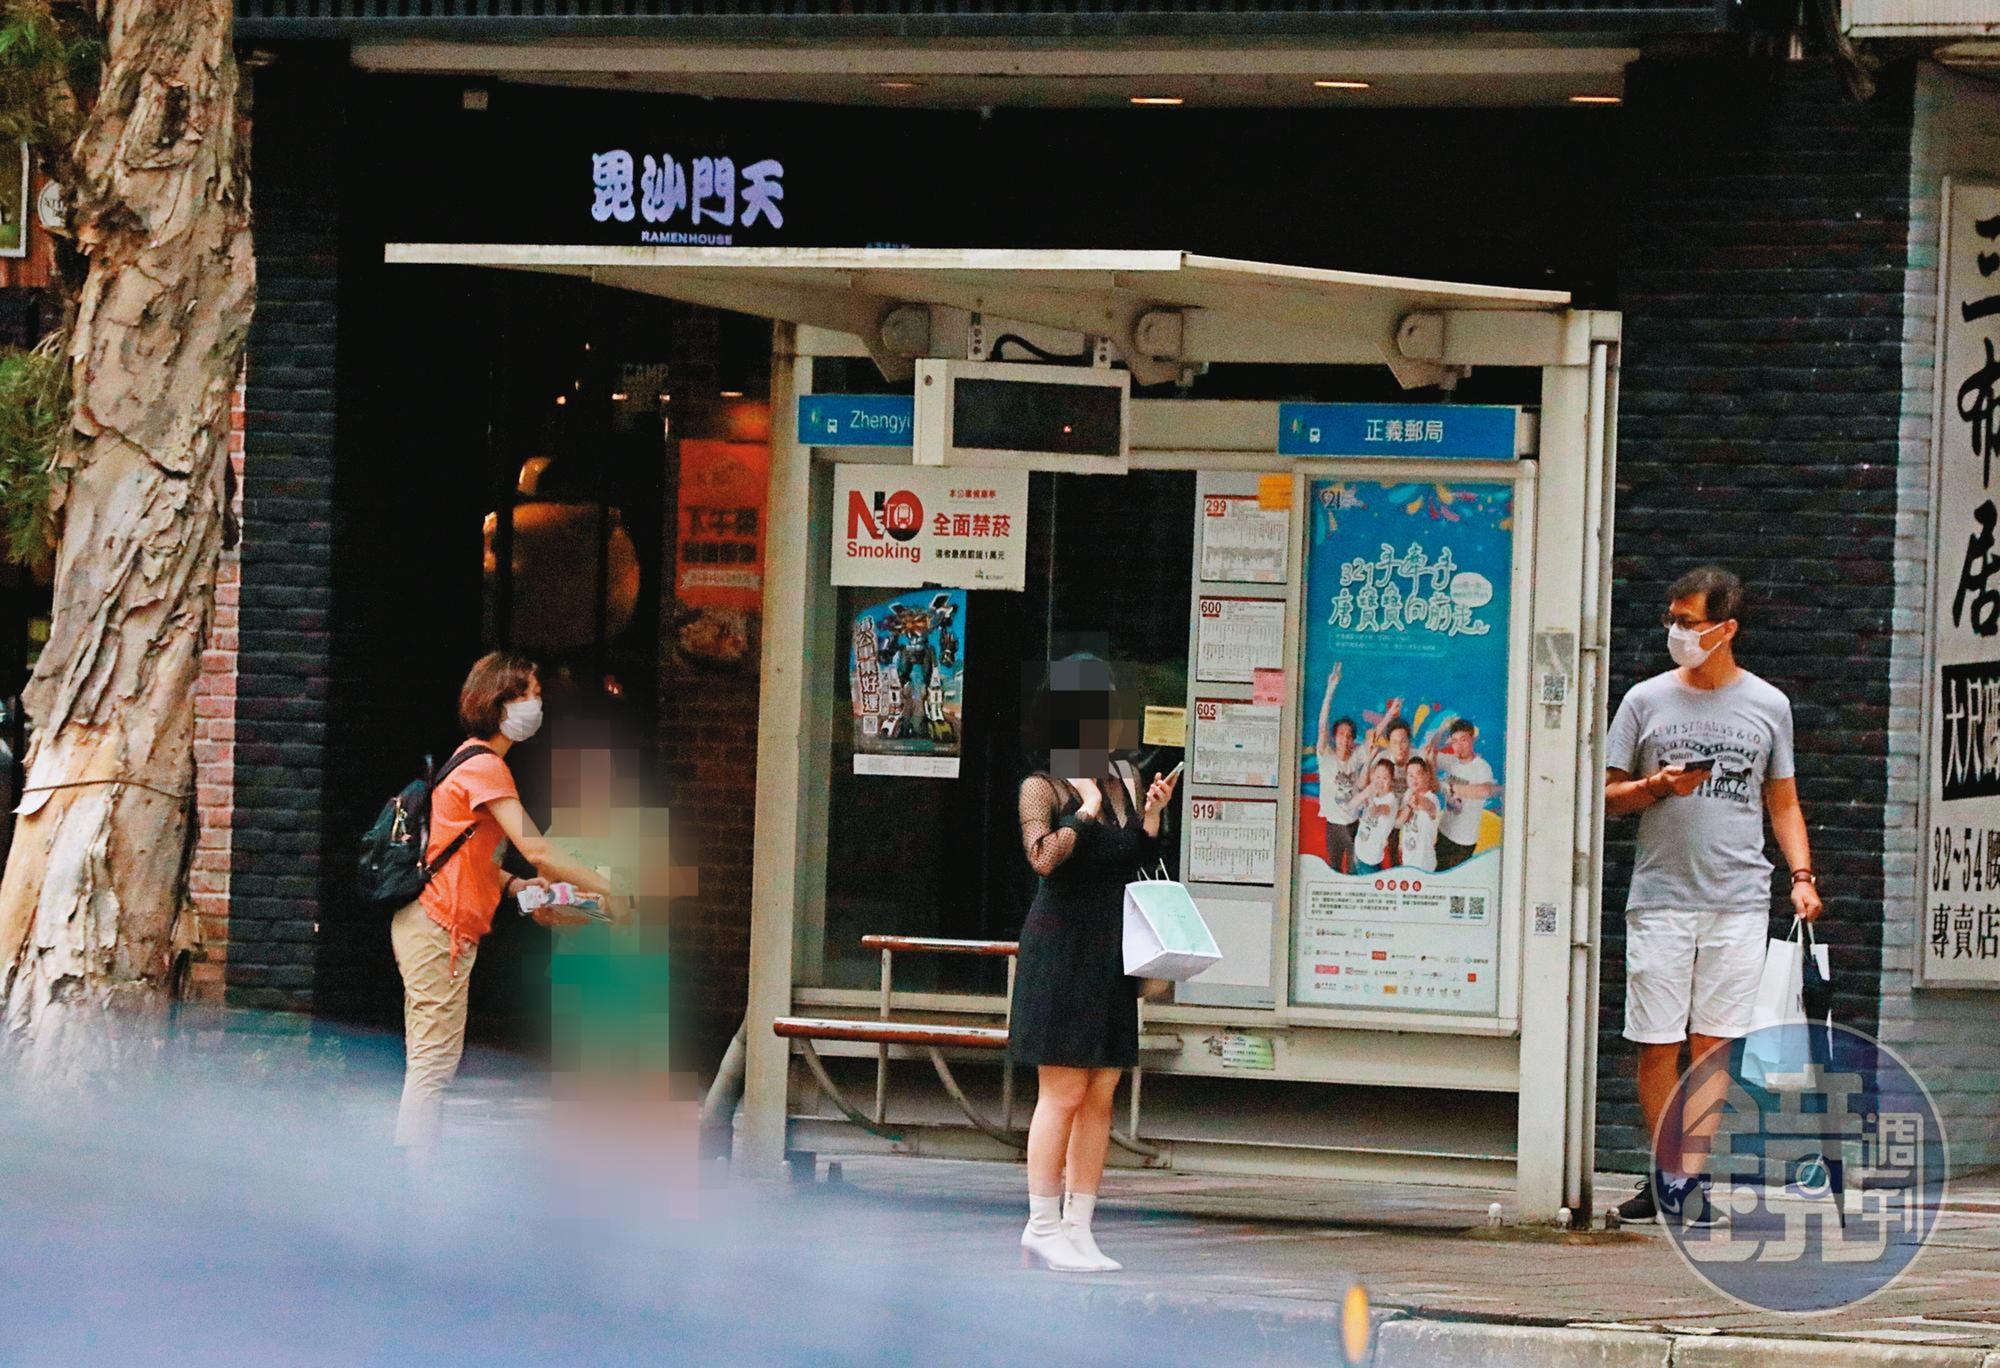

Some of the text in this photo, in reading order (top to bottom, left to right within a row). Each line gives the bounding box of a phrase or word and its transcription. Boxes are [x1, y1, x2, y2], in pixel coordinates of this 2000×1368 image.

[591, 149, 785, 229] 毘沙門天
[850, 409, 910, 434] Zhengyi
[1365, 419, 1444, 443] 正義郵局
[847, 489, 924, 542] NO
[1206, 500, 1227, 512] 299
[933, 512, 1011, 537] 全面禁菸
[847, 541, 921, 563] Smoking
[1201, 602, 1222, 614] 600
[1197, 703, 1216, 716] 605
[1193, 803, 1214, 819] 919
[1931, 903, 2000, 960] 專賣店
